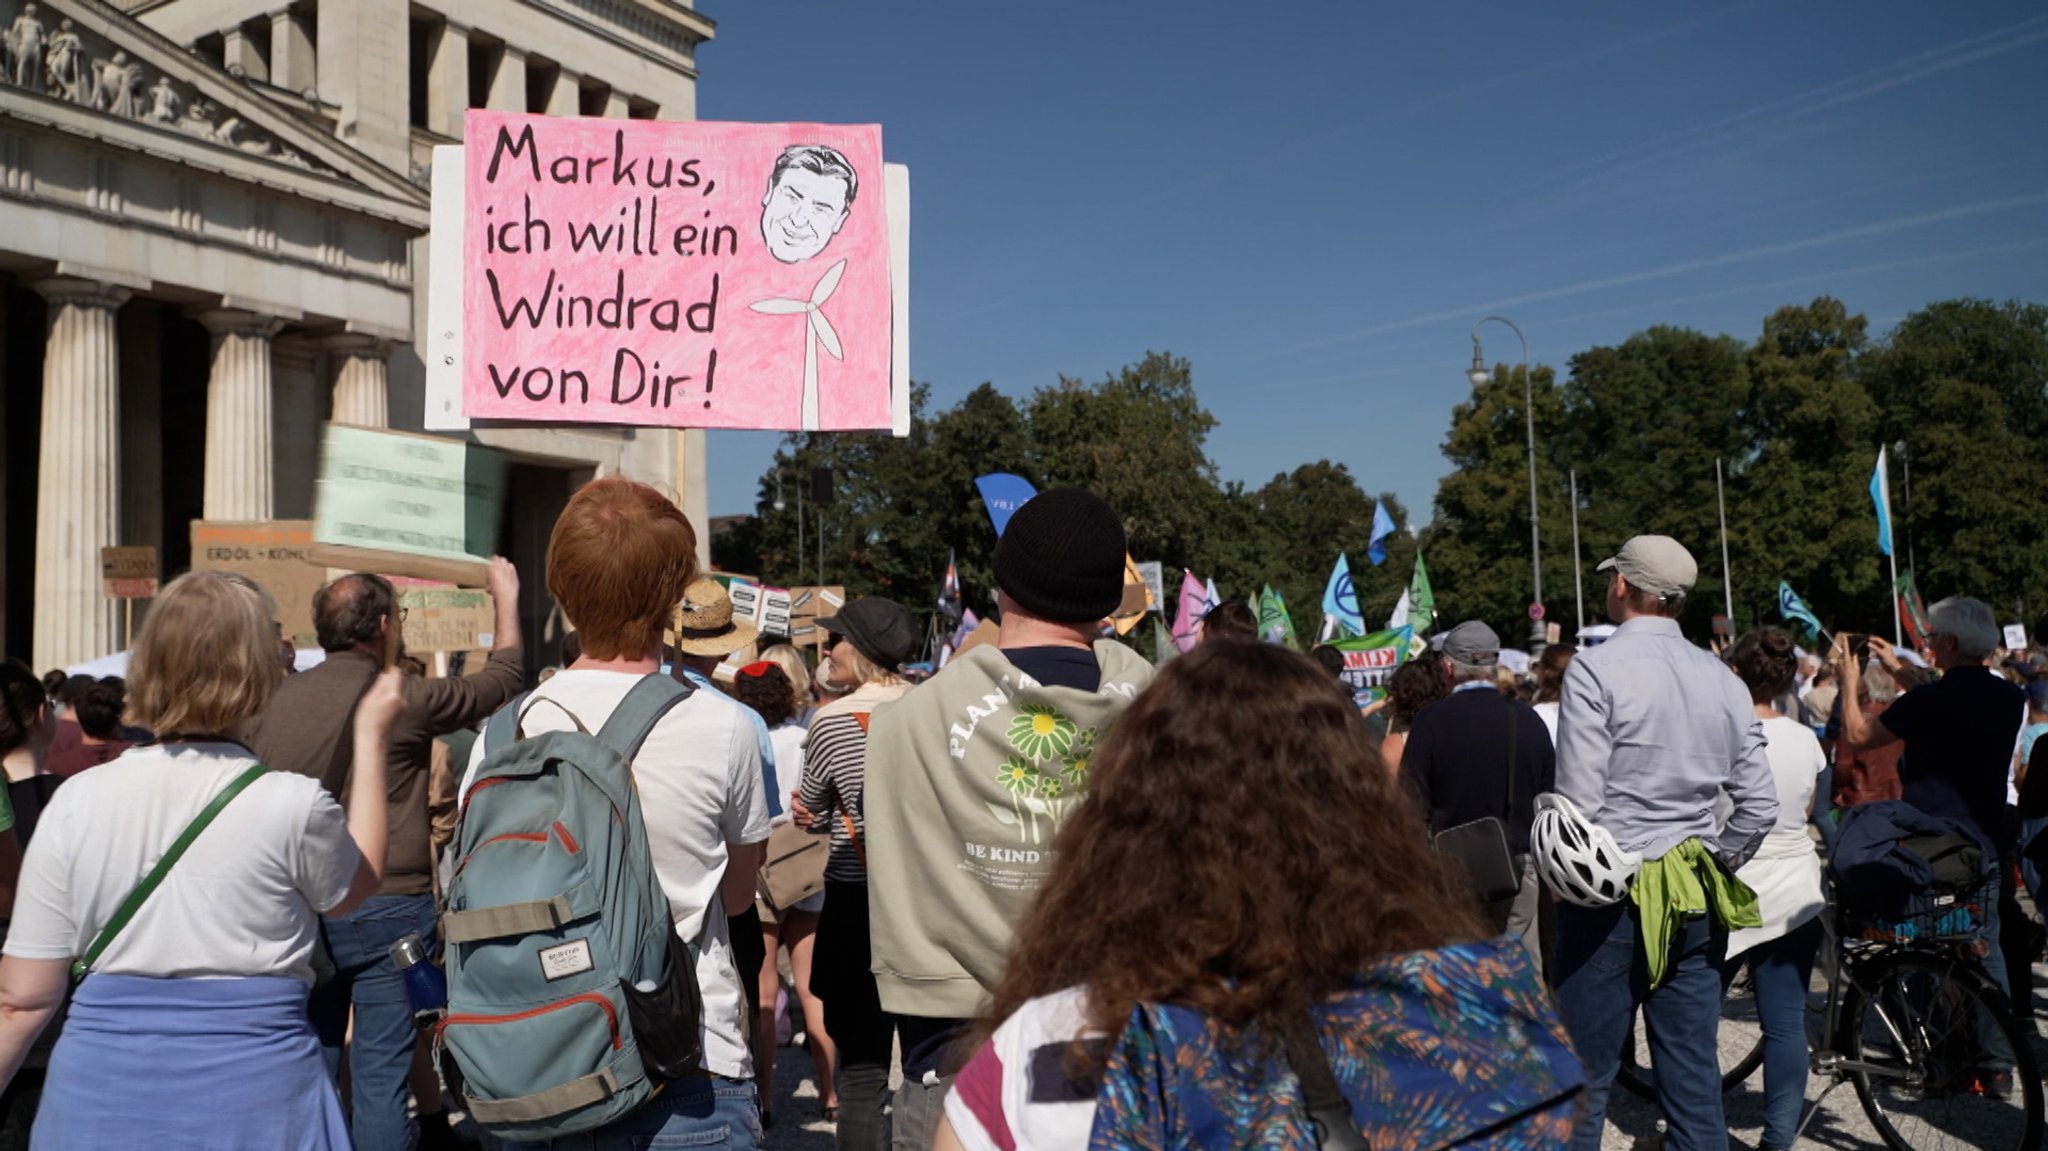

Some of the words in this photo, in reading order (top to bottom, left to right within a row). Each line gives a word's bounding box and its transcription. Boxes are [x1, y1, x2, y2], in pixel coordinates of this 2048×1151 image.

[486, 123, 716, 196] Markus,
[486, 193, 551, 254] ich
[568, 194, 659, 256] will
[673, 211, 738, 256] ein
[485, 268, 720, 334] Windrad
[488, 362, 590, 405] von
[965, 842, 987, 859] BE
[990, 846, 1041, 864] KIND
